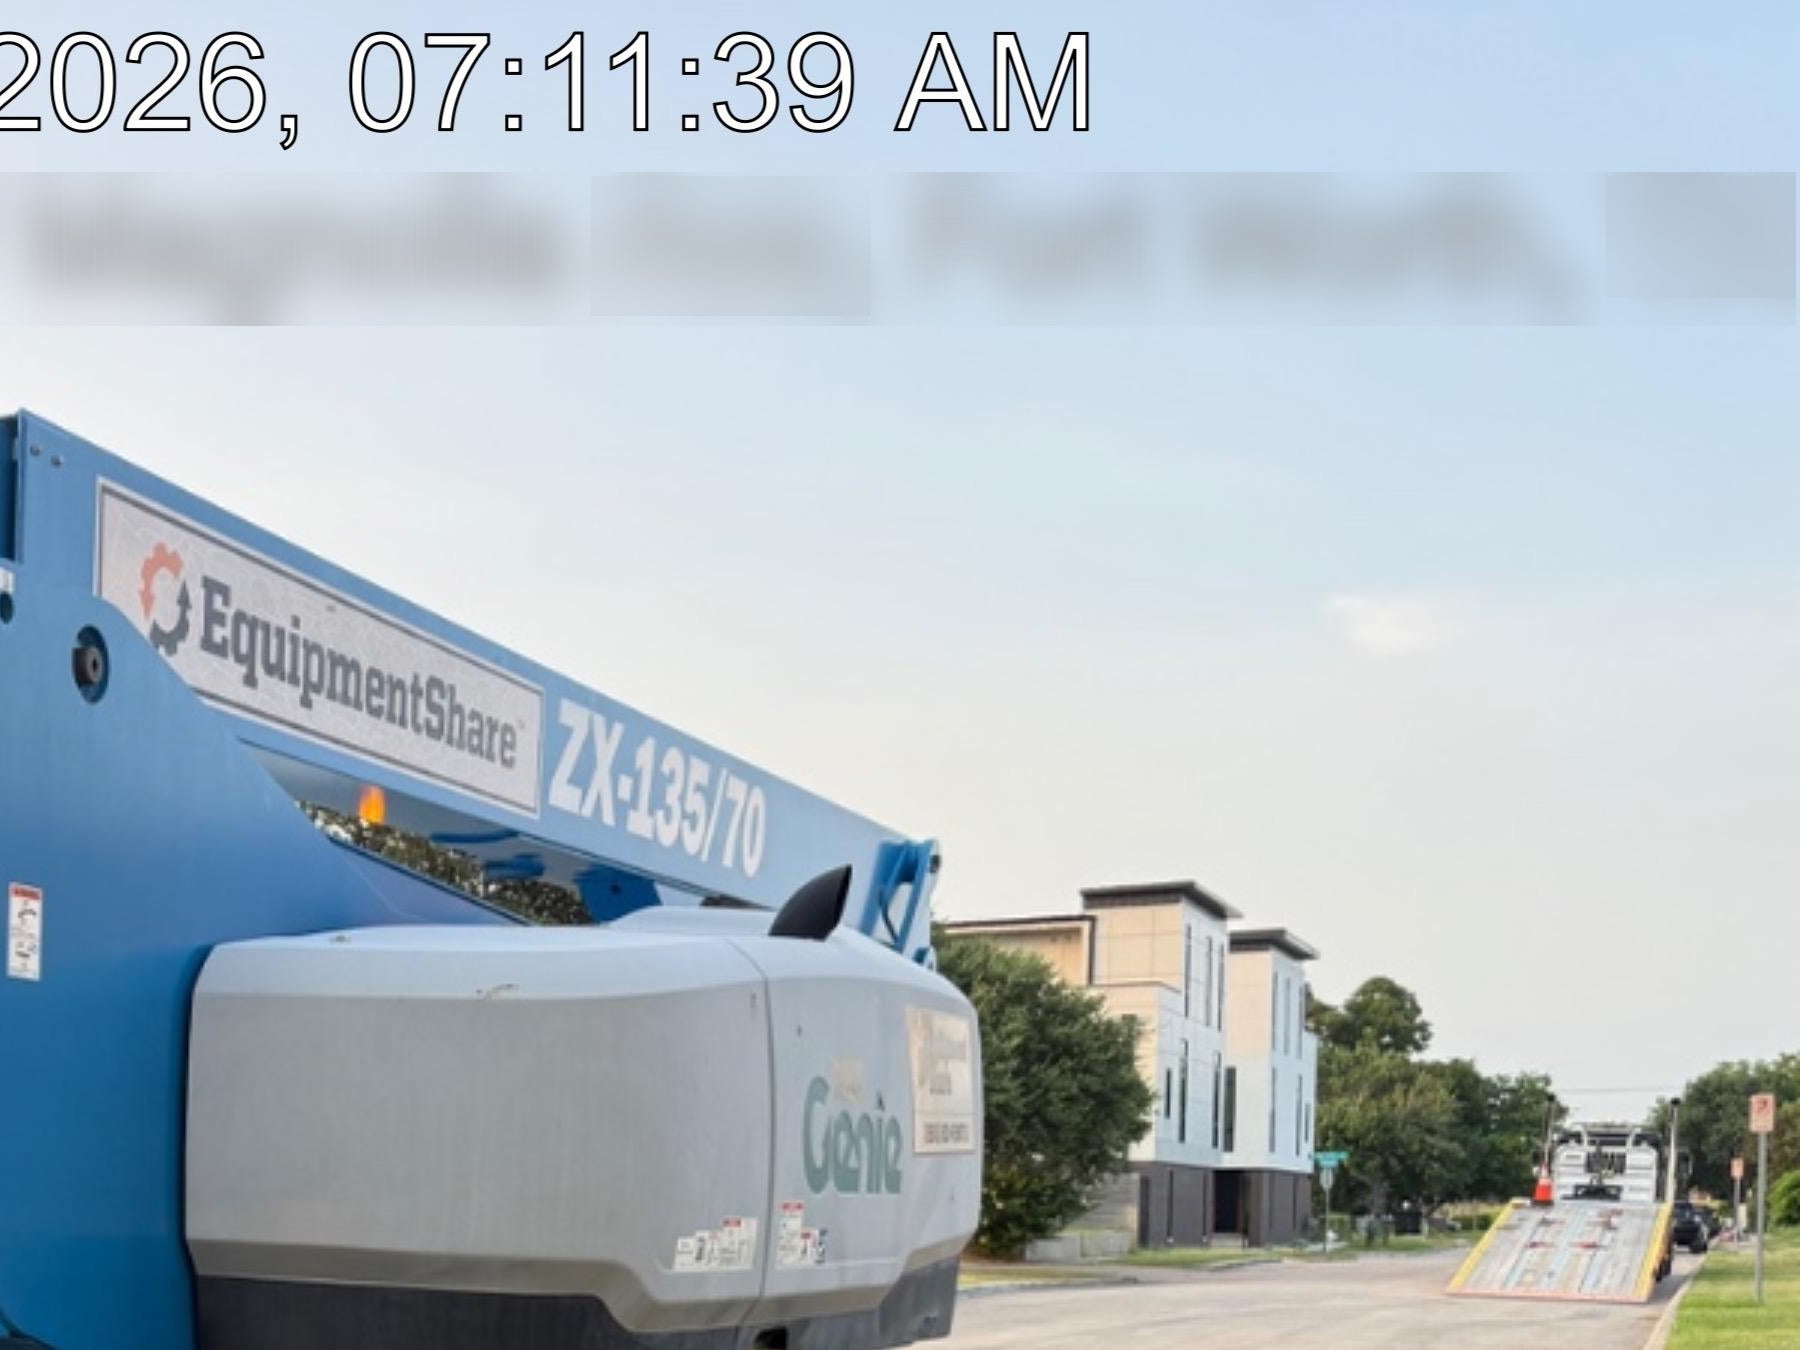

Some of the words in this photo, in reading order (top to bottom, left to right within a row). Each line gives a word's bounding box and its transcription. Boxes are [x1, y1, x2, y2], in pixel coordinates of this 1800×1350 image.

[200, 574, 518, 771] EquipmentShare
[549, 698, 765, 878] ZX-135/70
[803, 1076, 904, 1194] Genie
